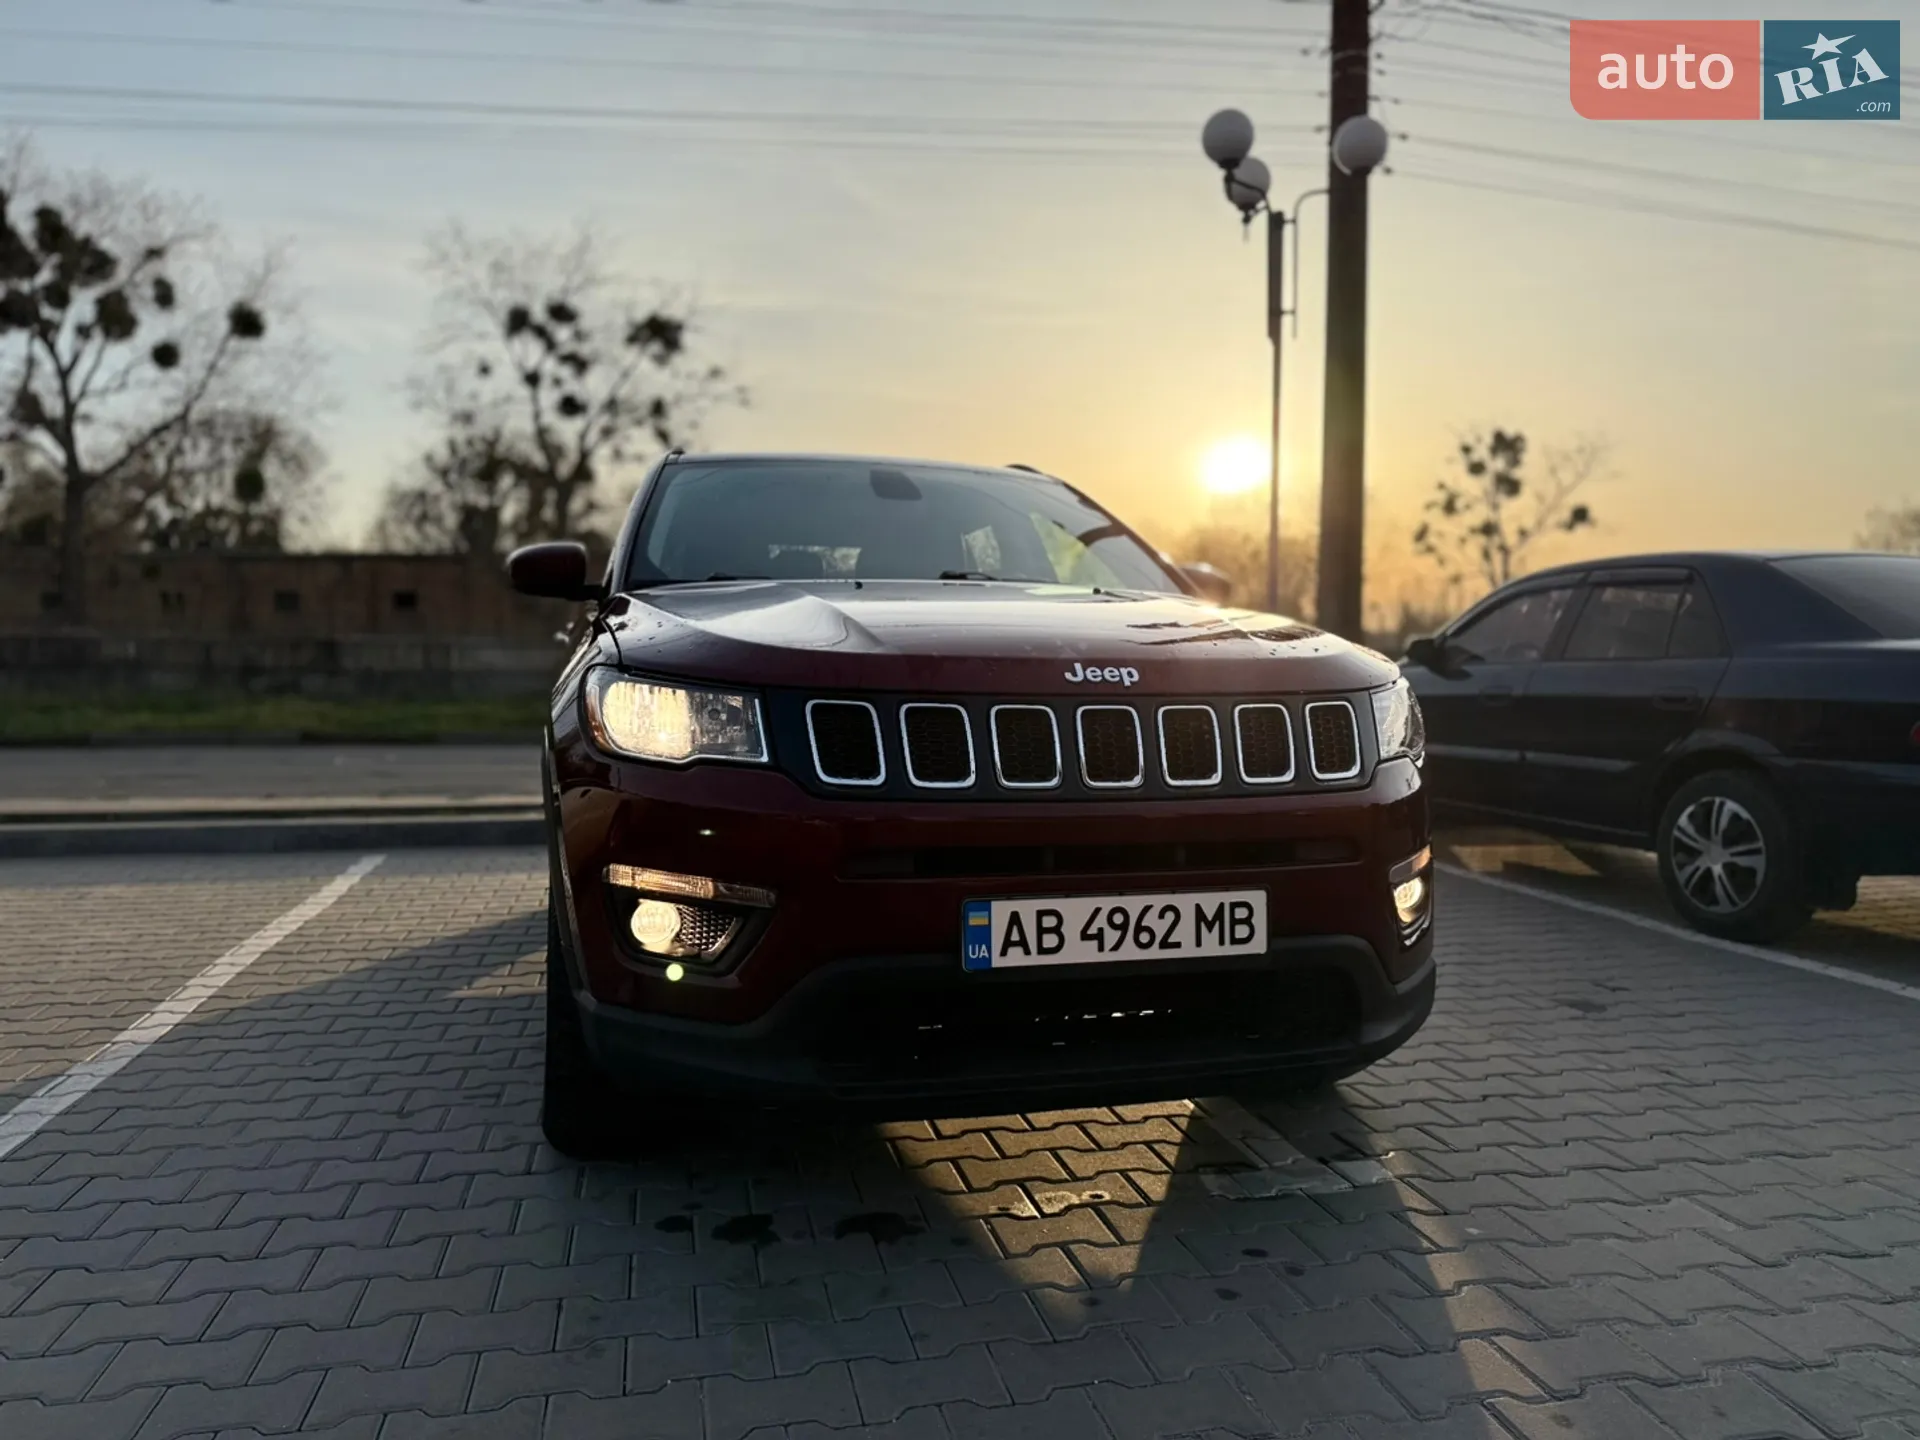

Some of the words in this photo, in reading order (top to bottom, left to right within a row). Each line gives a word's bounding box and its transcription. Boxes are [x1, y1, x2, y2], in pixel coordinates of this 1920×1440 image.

[1064, 662, 1139, 687] Jeep
[999, 908, 1066, 957] AB
[1080, 904, 1182, 953] 4962
[1194, 901, 1256, 948] MB
[968, 944, 989, 959] UA
